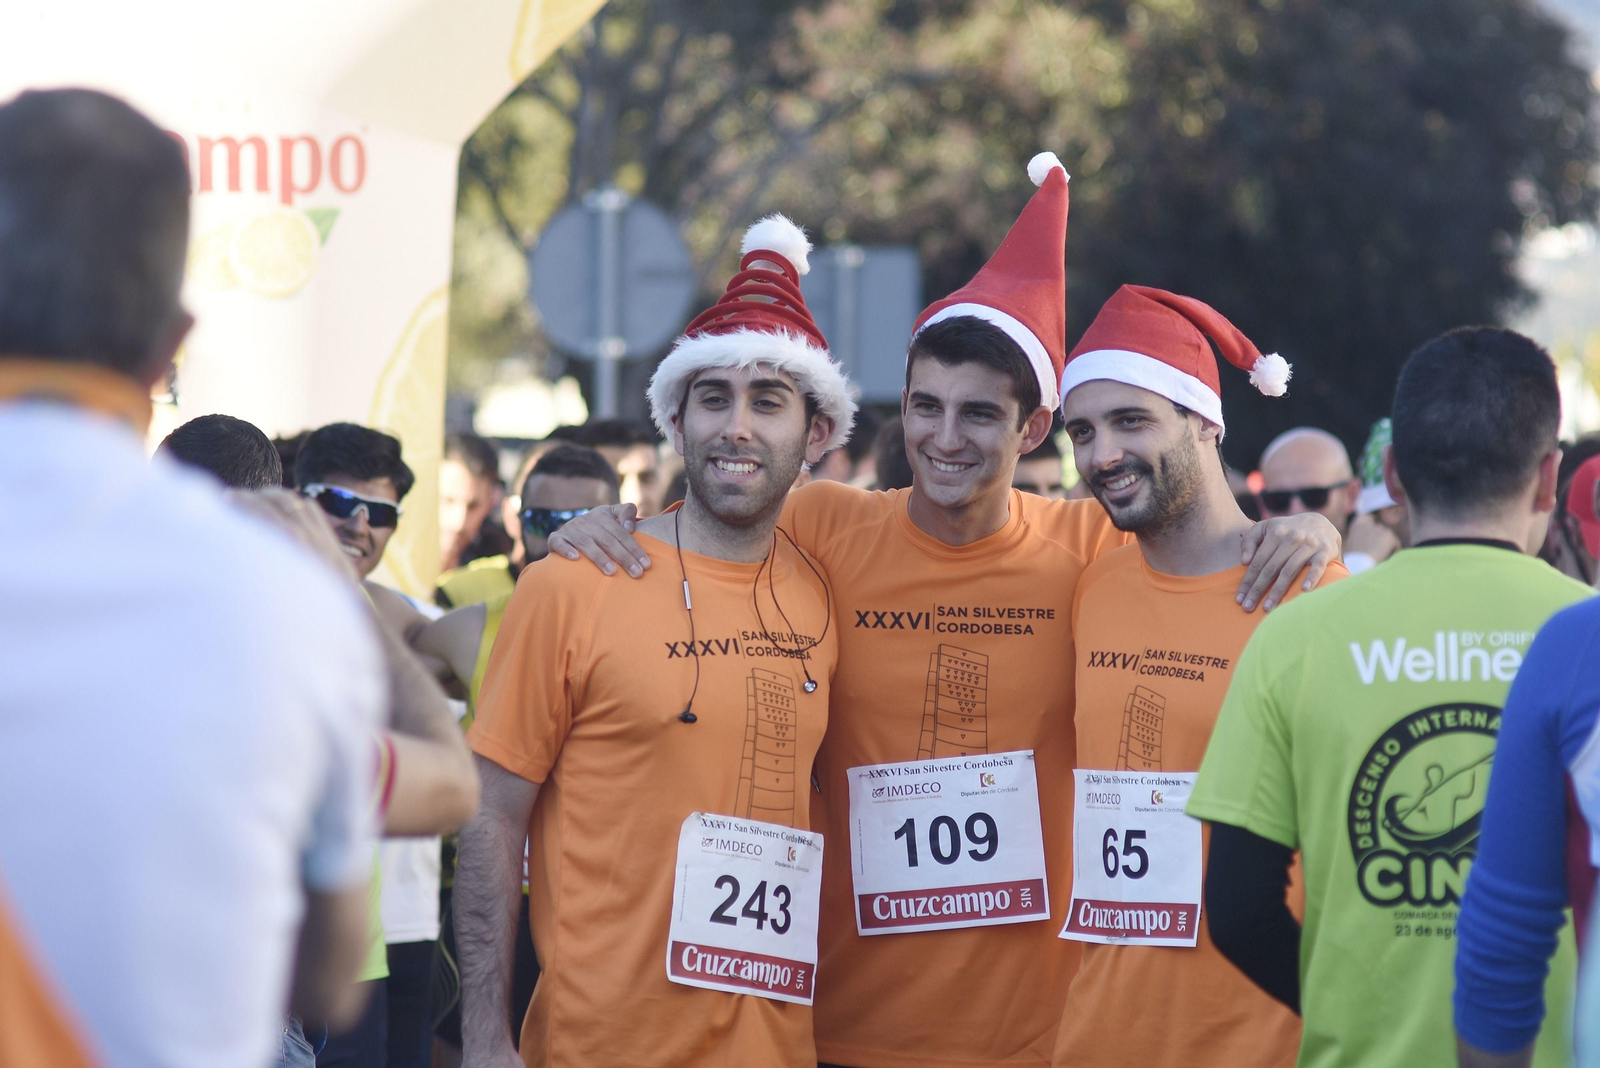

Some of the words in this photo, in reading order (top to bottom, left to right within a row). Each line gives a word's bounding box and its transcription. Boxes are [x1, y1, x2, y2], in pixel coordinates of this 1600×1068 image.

[167, 132, 367, 207] mpo
[854, 610, 930, 630] XXXVI
[937, 606, 968, 617] SAN
[973, 607, 1055, 619] SILVESTRE
[742, 631, 768, 641] SAN
[771, 632, 817, 647] SILVESTRE
[936, 622, 1034, 635] CORDOBESA
[665, 638, 740, 659] XXXVI
[1461, 632, 1485, 647] BY
[1489, 632, 1535, 647] ORIF
[745, 646, 812, 660] CORDOBESA
[1087, 651, 1140, 671] XXXVI
[1145, 649, 1166, 661] SAN
[1168, 651, 1230, 669] SILVESTRE
[1349, 630, 1523, 685] Wellne
[1139, 664, 1205, 682] CORDOBESA
[868, 768, 901, 779] XXXVI
[904, 767, 921, 776] San
[923, 764, 962, 774] Silvestre
[964, 758, 1014, 770] Cordobesa
[887, 781, 942, 797] IMDECO
[1112, 776, 1139, 785] Silvestre
[1140, 776, 1181, 786] Cordobesa
[1091, 793, 1121, 805] IMDECO
[1354, 738, 1401, 849] DESCENSO
[701, 818, 732, 831] XXXVI
[734, 823, 748, 833] San
[749, 826, 780, 839] Silvestre
[716, 838, 763, 856] IMDECO
[894, 812, 999, 868] 109
[1102, 828, 1149, 880] 65
[709, 874, 792, 935] 243
[872, 889, 1011, 920] Cruzcampo
[1020, 887, 1032, 908] SIN
[1078, 901, 1171, 935] Cruzcampo
[1177, 911, 1188, 932] SIN
[1415, 924, 1432, 937] de
[681, 945, 792, 989] Cruzcampo
[795, 969, 805, 990] SIN
